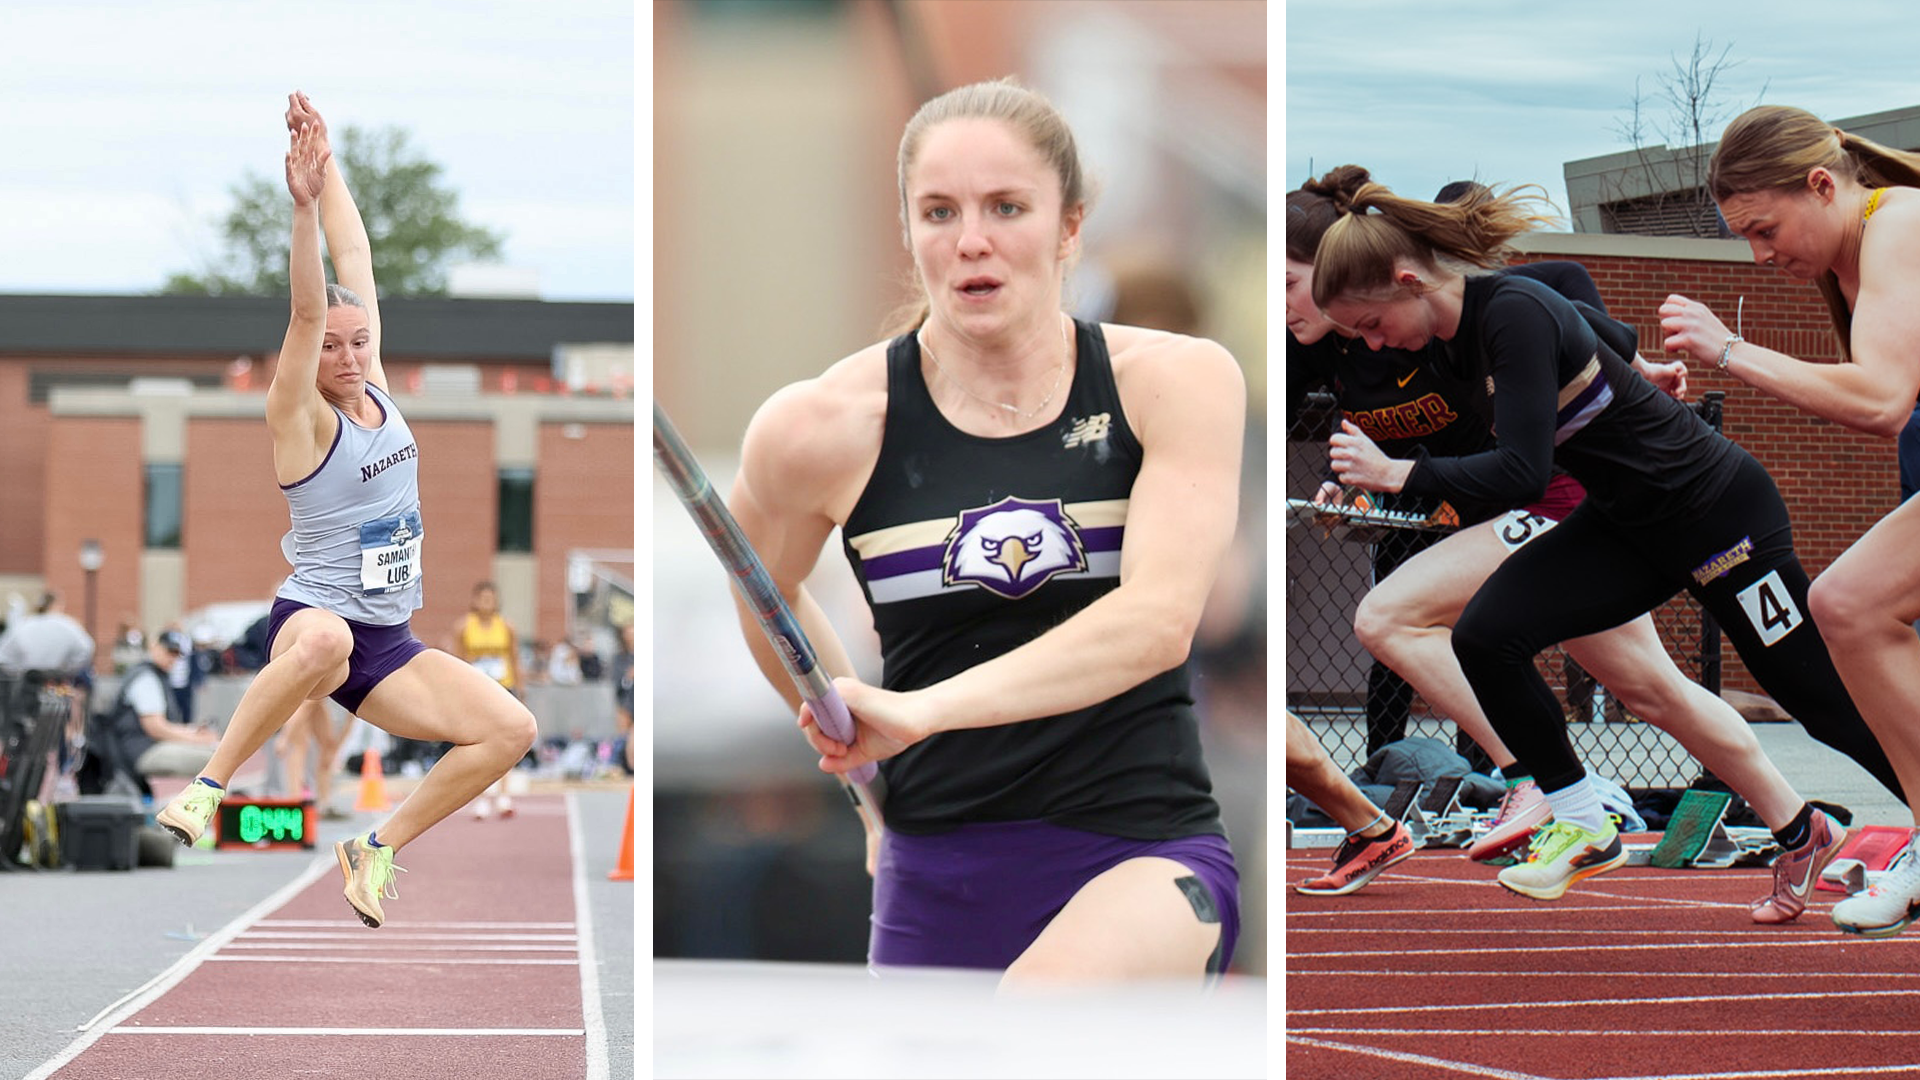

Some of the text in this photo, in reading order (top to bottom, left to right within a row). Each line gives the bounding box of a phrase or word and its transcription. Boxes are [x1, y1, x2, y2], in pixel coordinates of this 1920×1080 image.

[360, 442, 417, 483] NAZARETH
[1502, 512, 1532, 545] 5
[1691, 538, 1752, 584] NAZARETH
[1758, 581, 1792, 632] 4
[1345, 835, 1409, 882] new balance
